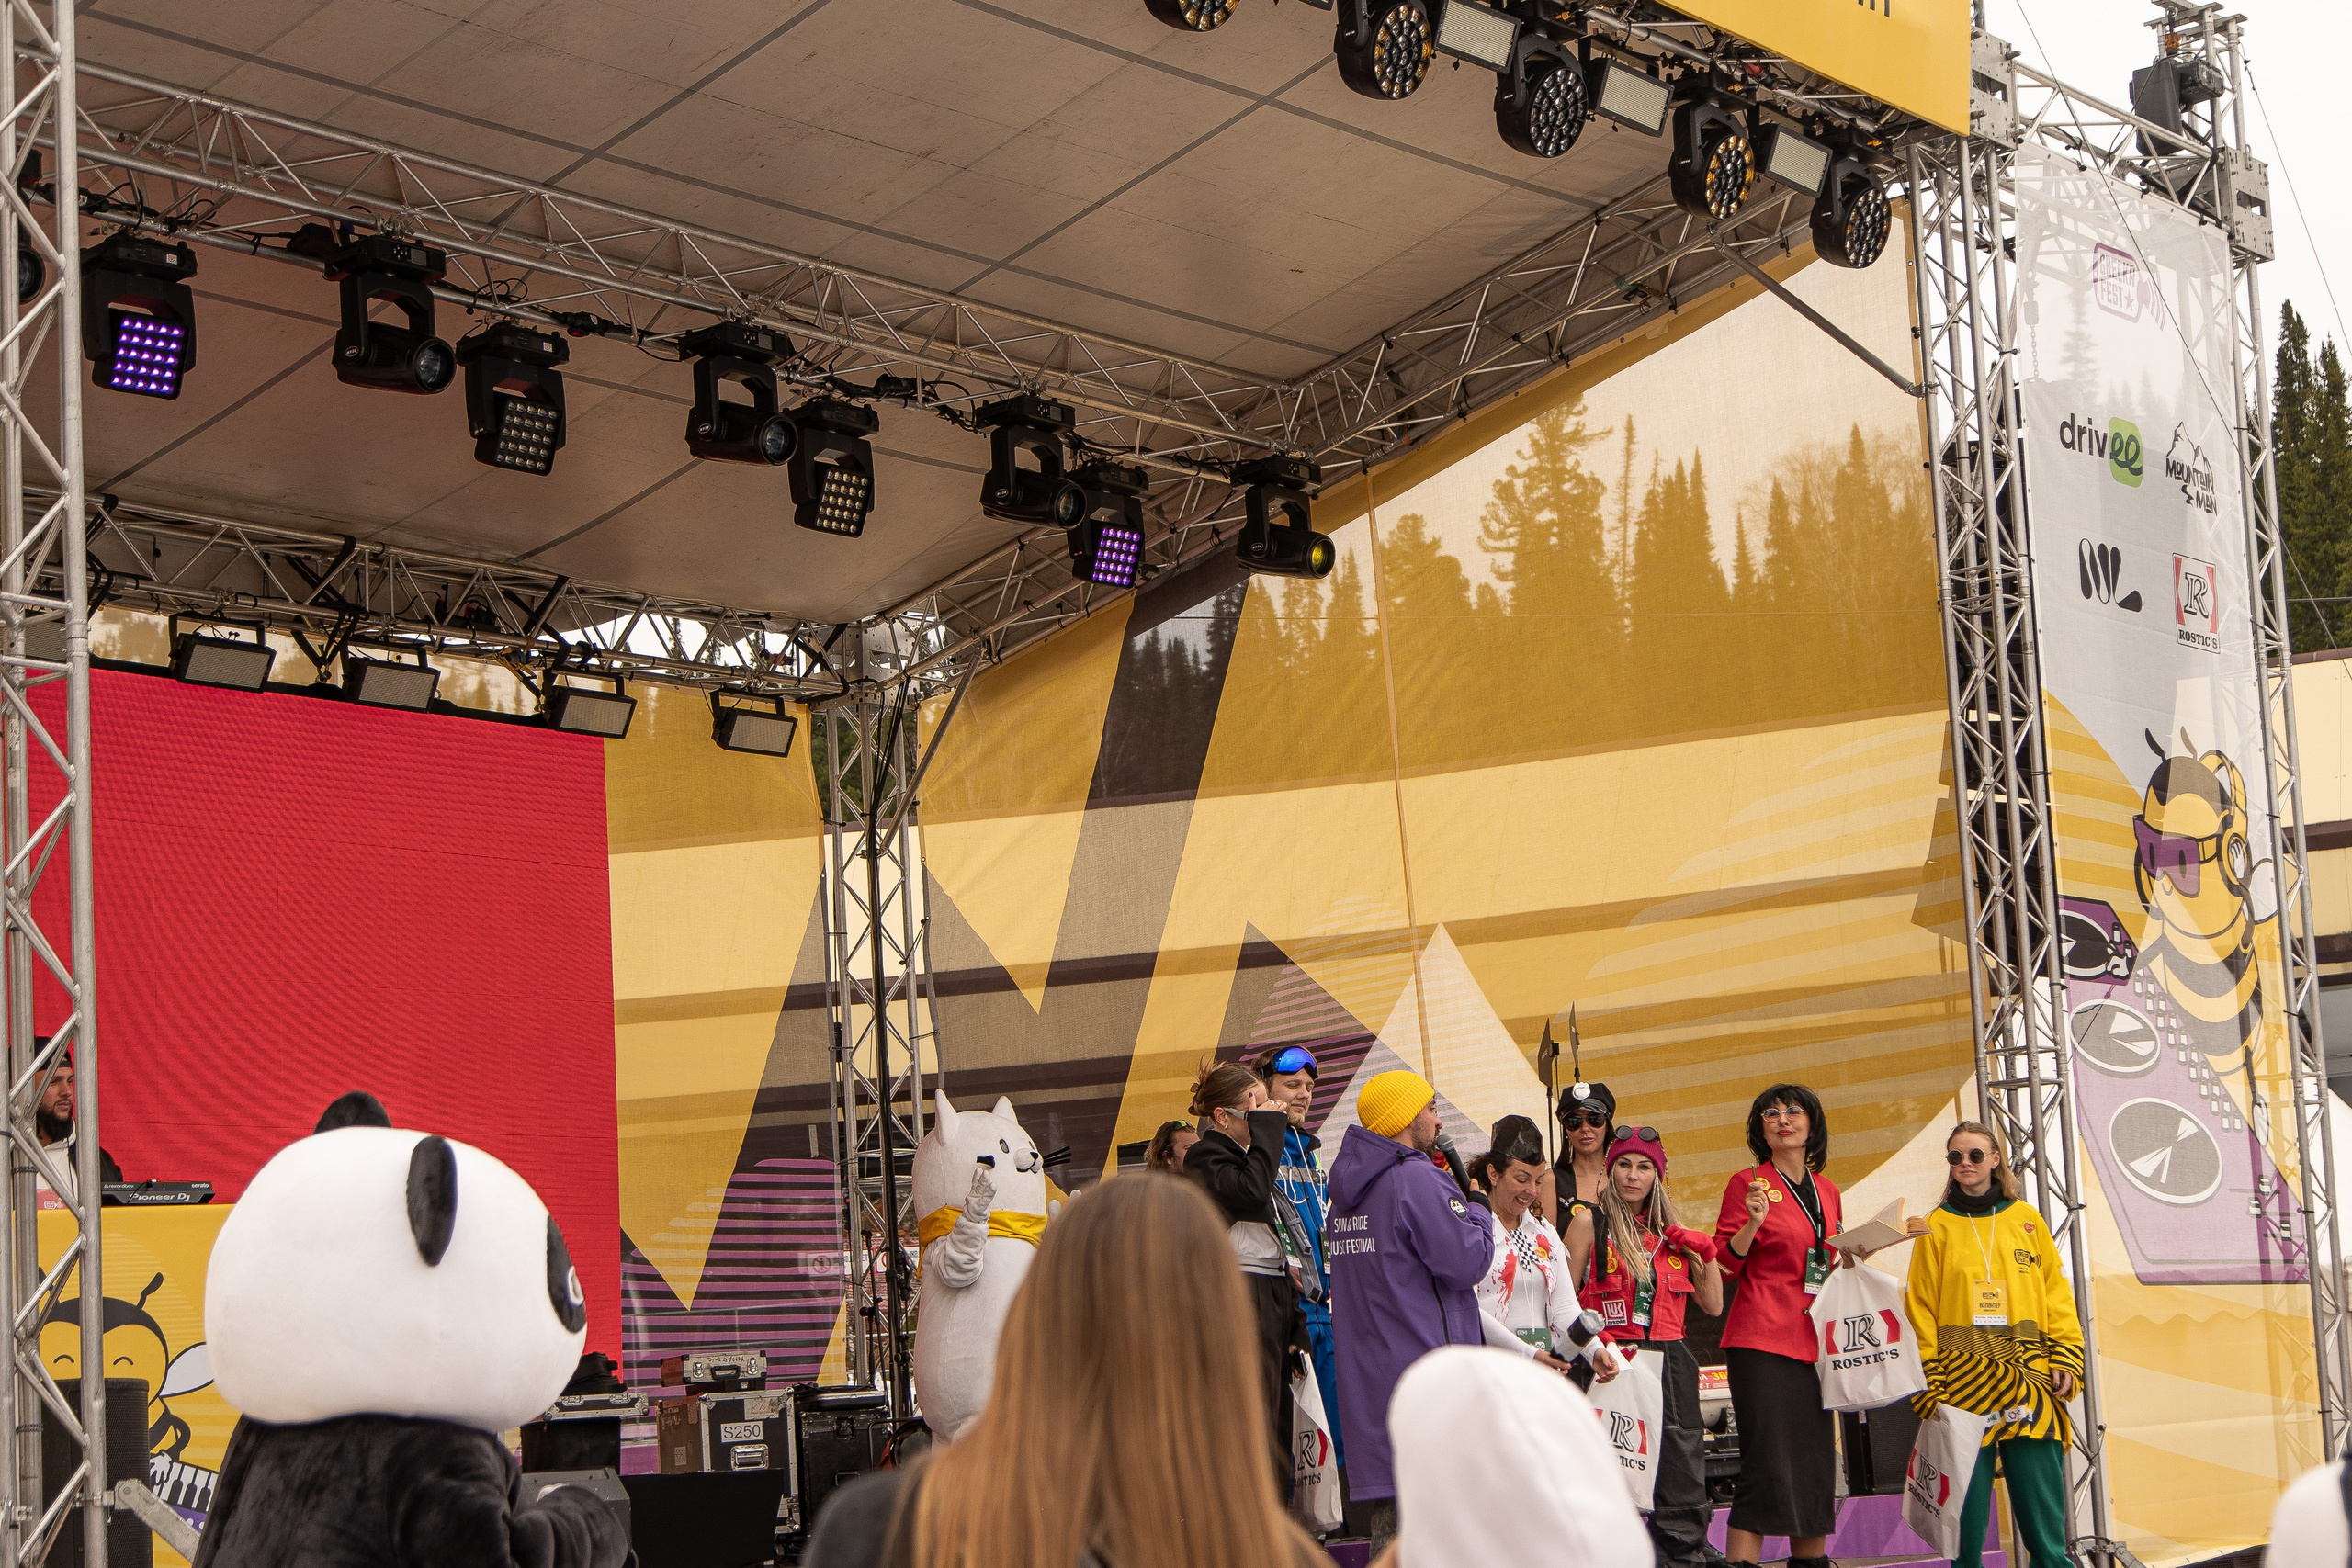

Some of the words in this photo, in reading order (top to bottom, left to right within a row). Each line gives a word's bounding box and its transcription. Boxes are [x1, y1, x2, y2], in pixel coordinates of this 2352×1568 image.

[2100, 278, 2124, 308] FEST
[2060, 412, 2143, 477] drivee
[2165, 457, 2215, 495] MOUNTAIN
[2196, 490, 2218, 516] MAN
[2178, 628, 2218, 649] ROSTIC'S
[130, 1192, 175, 1201] Pioneer
[1352, 1215, 1369, 1231] RIDE
[1831, 1348, 1900, 1371] ROSTIC'S
[723, 1424, 761, 1439] S250
